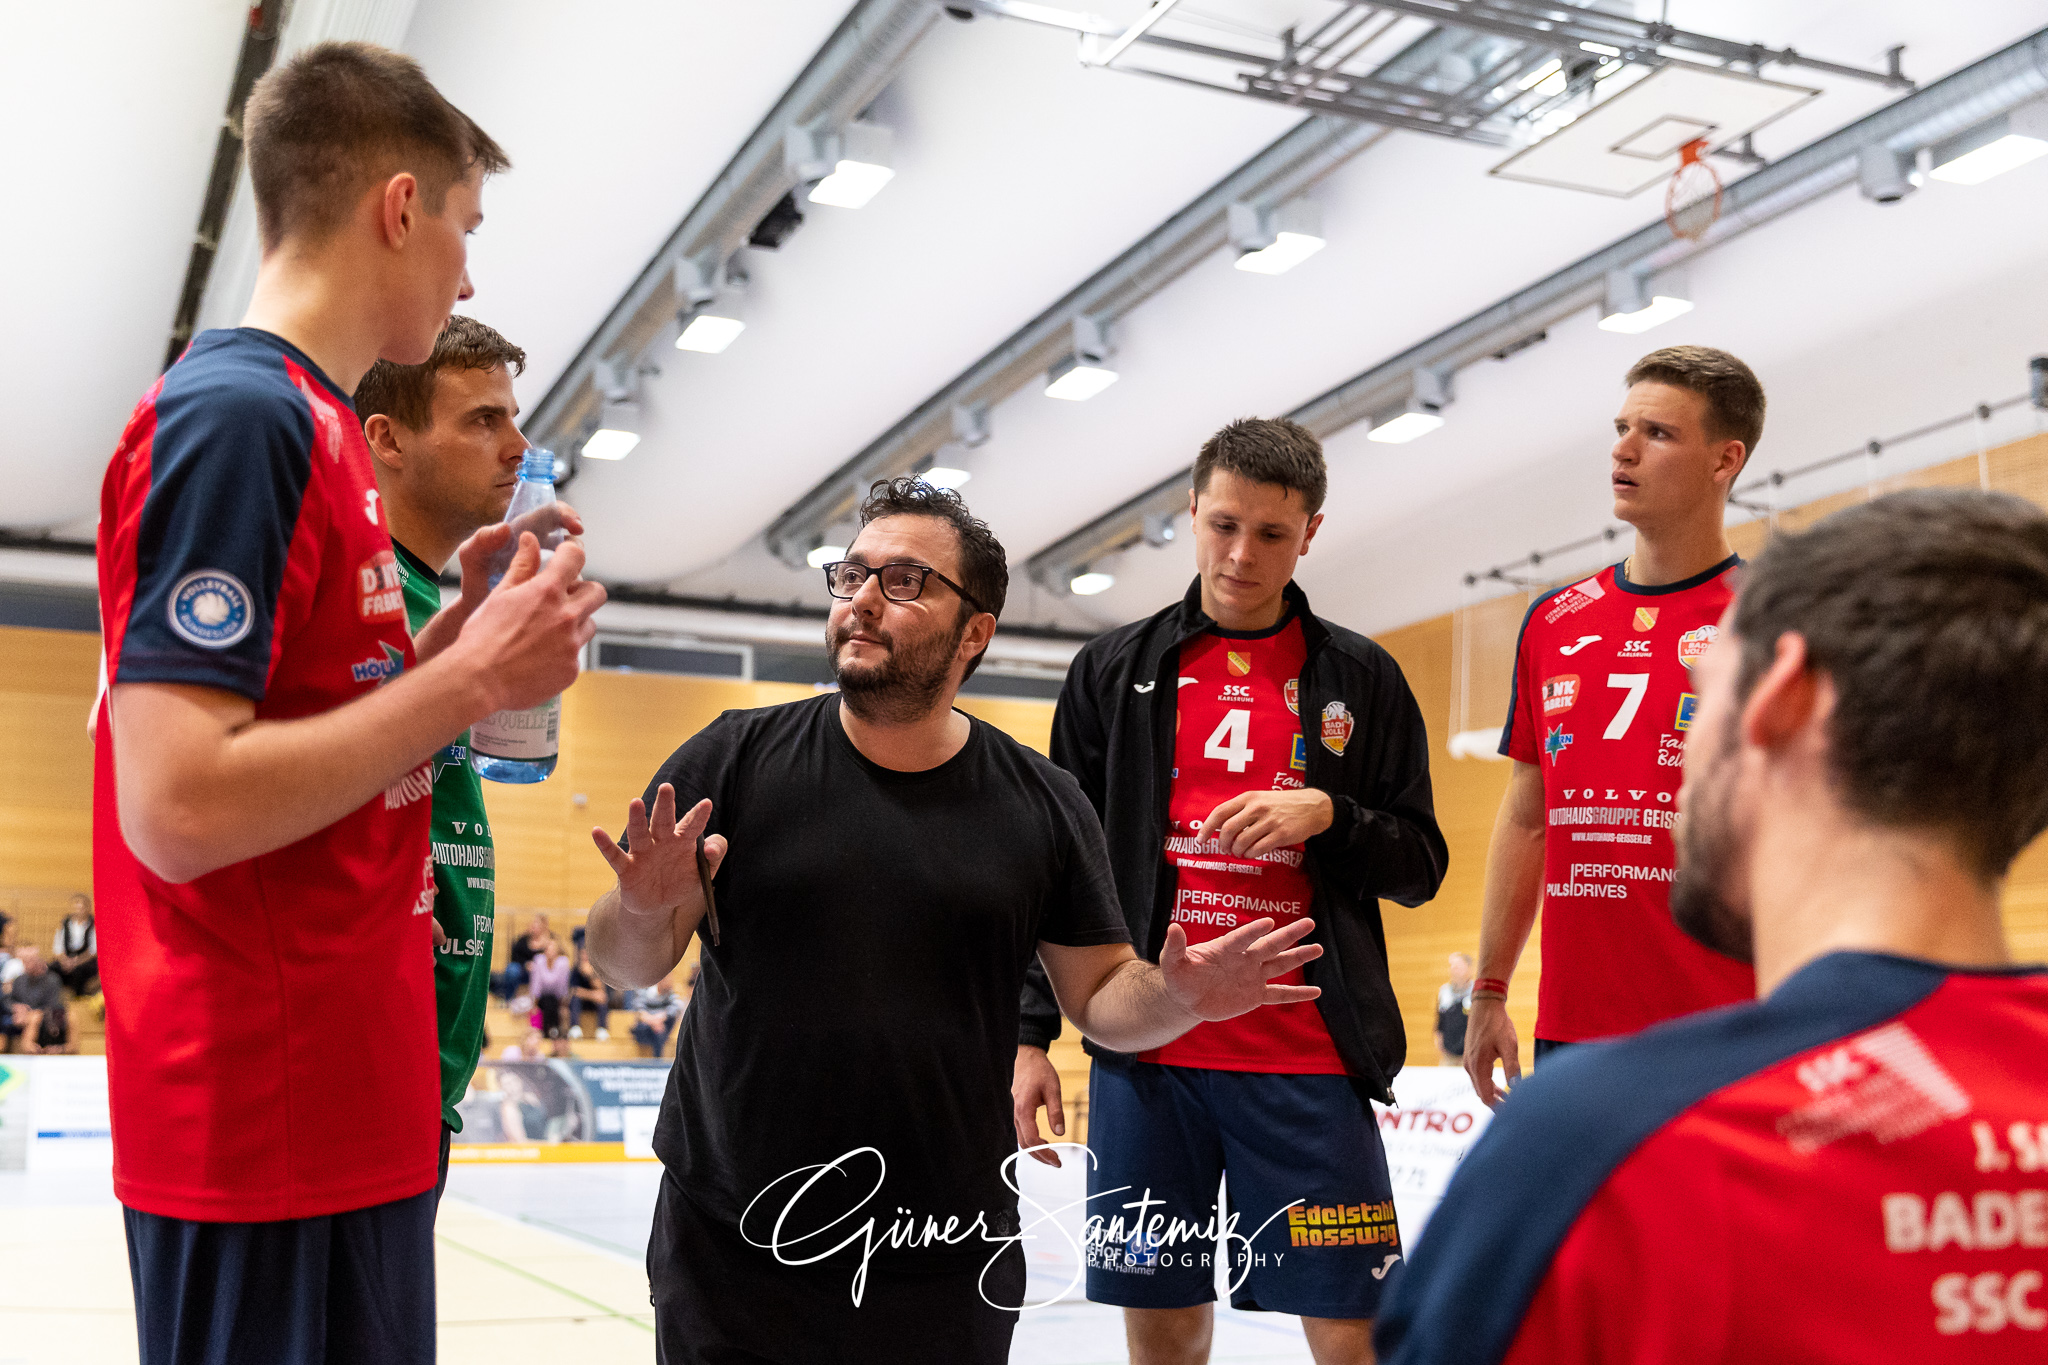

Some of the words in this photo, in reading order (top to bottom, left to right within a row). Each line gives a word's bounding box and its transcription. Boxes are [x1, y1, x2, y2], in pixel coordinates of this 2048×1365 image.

[1553, 589, 1574, 606] SSC
[1623, 640, 1651, 652] SSC
[1217, 694, 1254, 703] KARLSRUHE
[1223, 684, 1251, 697] SSC
[1602, 673, 1650, 740] 7
[499, 712, 549, 732] QUELLE
[1203, 708, 1255, 774] 4
[1562, 788, 1673, 803] VOLVO
[1549, 806, 1641, 826] AUTOHAUSGRUPPE
[1642, 808, 1682, 830] GEISS
[1571, 832, 1652, 845] WWW.AUTOHAUS-GEISSER.DE
[1176, 857, 1263, 876] WWW.AUTOHAUS-GEISSER.DE
[1574, 863, 1681, 883] PERFORMANC
[1546, 883, 1570, 897] PULS
[1574, 883, 1628, 899] DRIVES
[1182, 889, 1301, 915] PERFORMANCE
[1180, 908, 1237, 927] DRIVES
[1287, 1200, 1395, 1226] Edelstahl
[1289, 1223, 1398, 1247] Rosswag
[1115, 1262, 1156, 1276] Hammer
[1932, 1269, 2047, 1335] SSC
